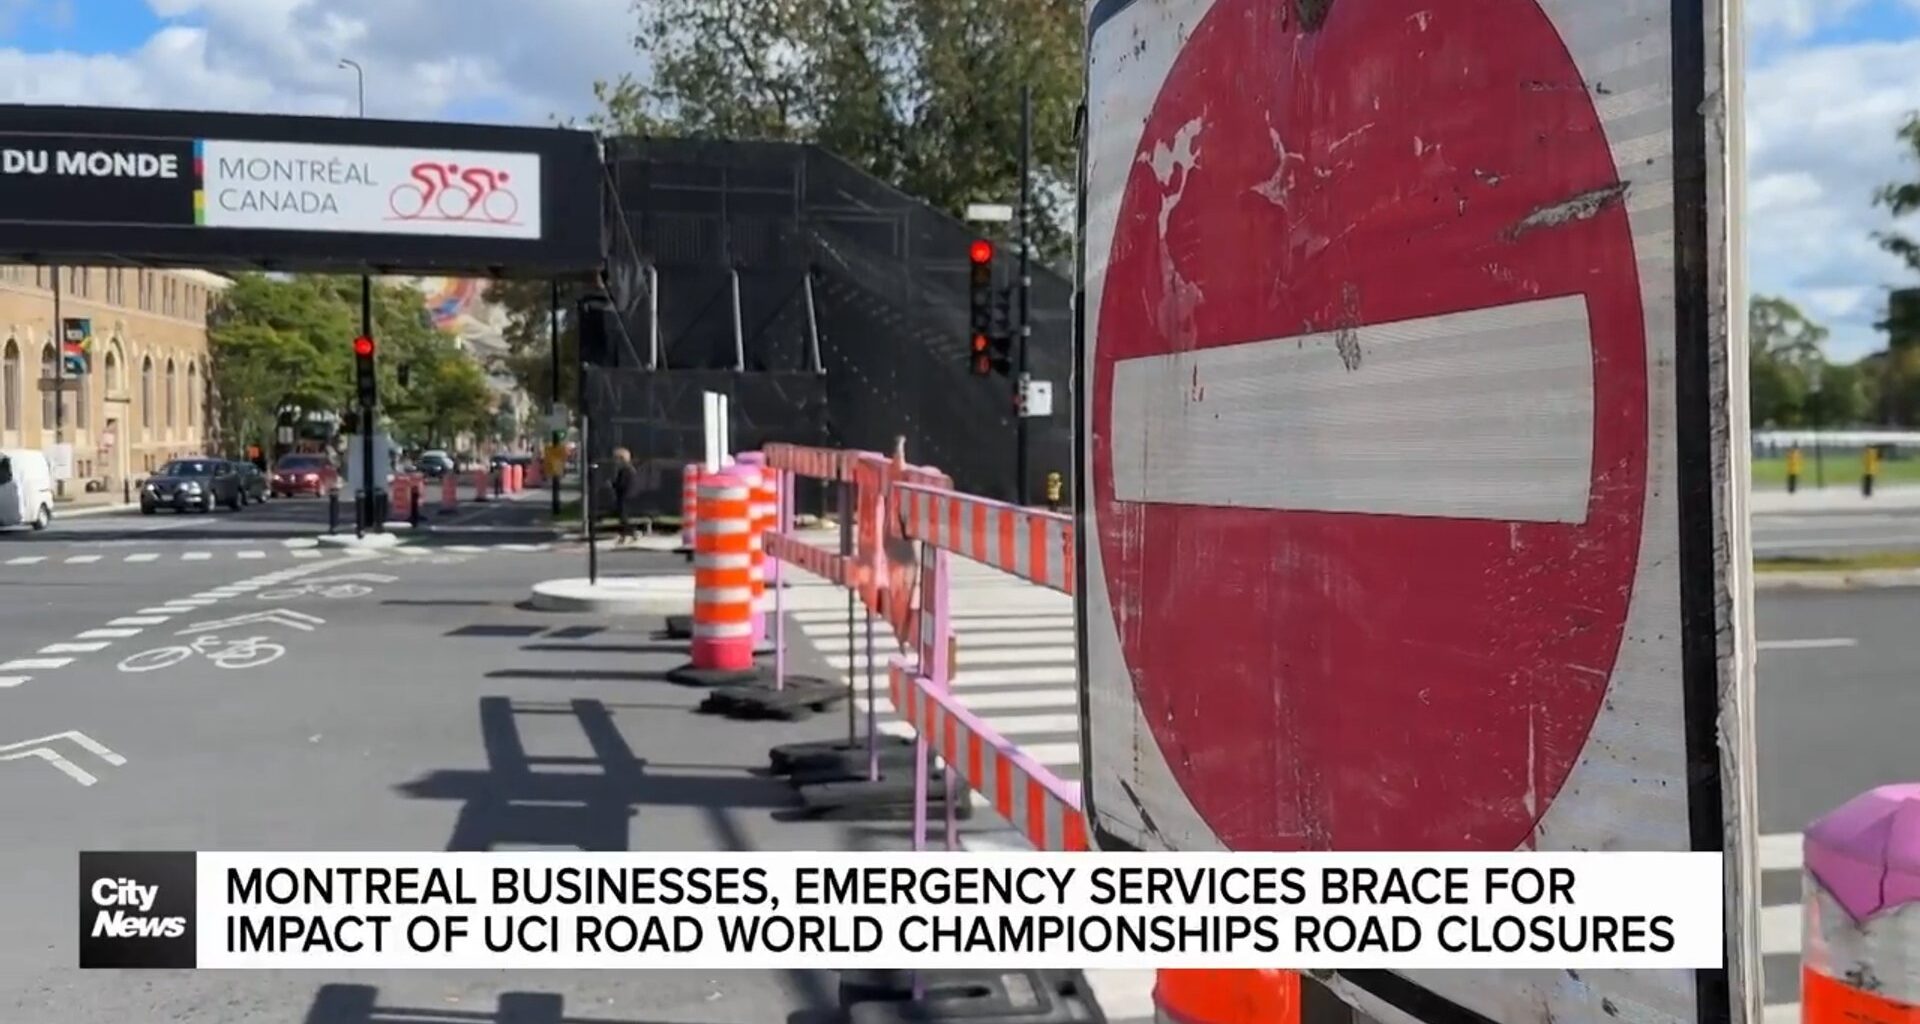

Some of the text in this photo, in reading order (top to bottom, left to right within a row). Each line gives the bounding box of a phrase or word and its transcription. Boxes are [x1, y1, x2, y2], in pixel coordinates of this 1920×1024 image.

[3, 149, 178, 178] DU MONDE
[218, 156, 378, 186] MONTRÉAL
[218, 188, 339, 215] CANADA
